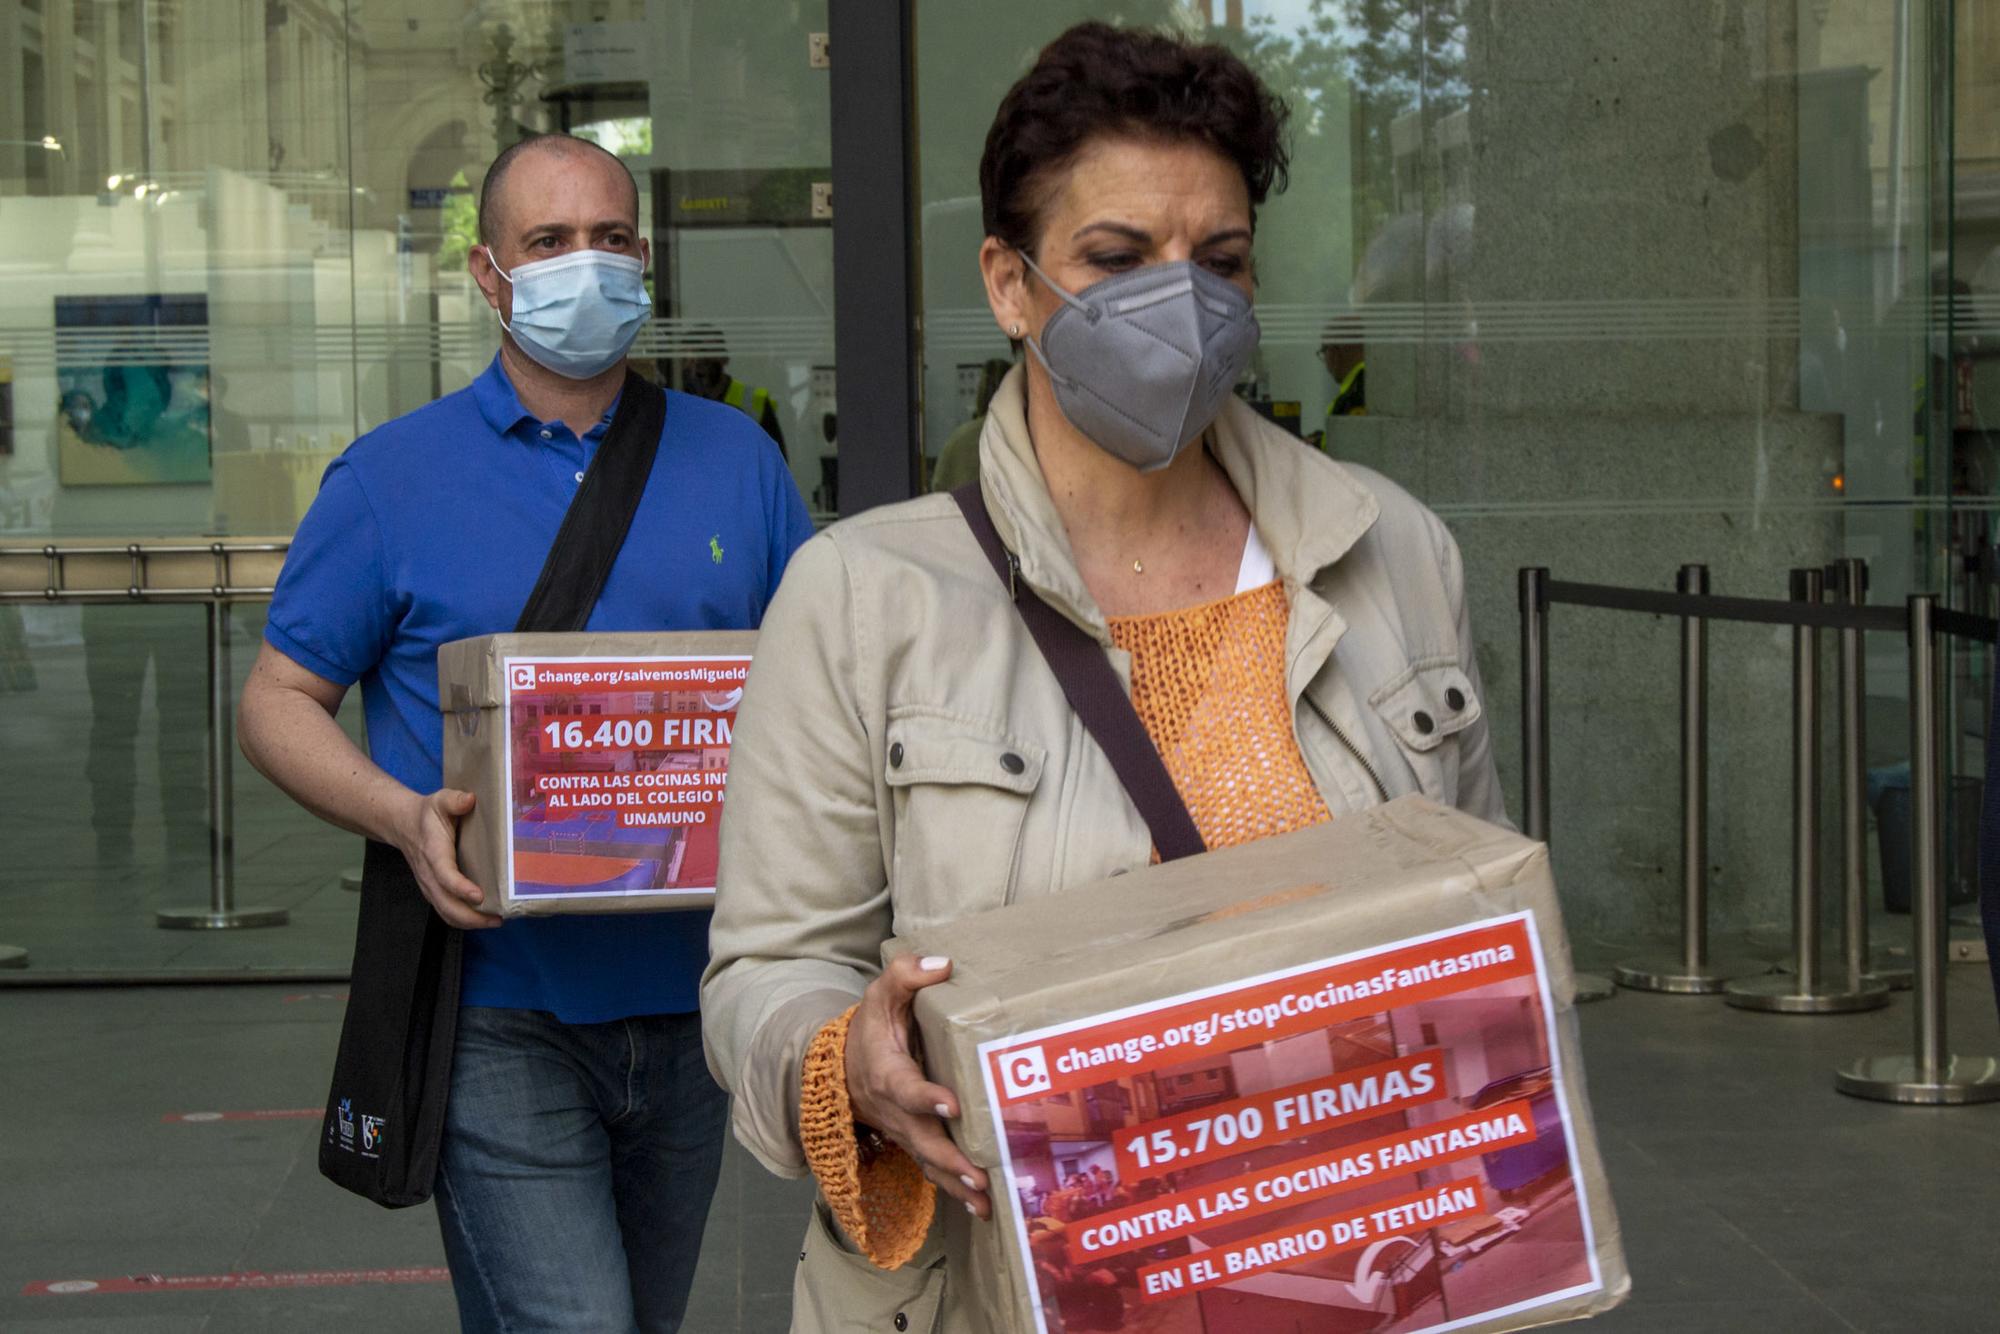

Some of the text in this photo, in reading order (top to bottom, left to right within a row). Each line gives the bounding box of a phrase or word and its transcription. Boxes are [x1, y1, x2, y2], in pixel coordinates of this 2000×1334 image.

[538, 667, 749, 684] change.org/salvemosMigueld
[545, 719, 653, 748] 16.400
[539, 775, 600, 790] CONTRA
[603, 774, 630, 788] LAS
[634, 773, 701, 787] COCINAS
[549, 794, 568, 807] AL
[572, 793, 612, 807] LADO
[616, 792, 643, 806] DEL
[647, 790, 713, 804] COLEGIO
[623, 811, 706, 825] UNAMUNO
[1056, 943, 1515, 1074] change.org/stopCocinasFantasma
[1126, 1062, 1435, 1168] 15.700 FIRMAS
[1081, 1113, 1527, 1251] CONTRA LAS COCINAS FANTASMA
[1145, 1187, 1476, 1295] EN EL BARRIO DE TETUÁN
